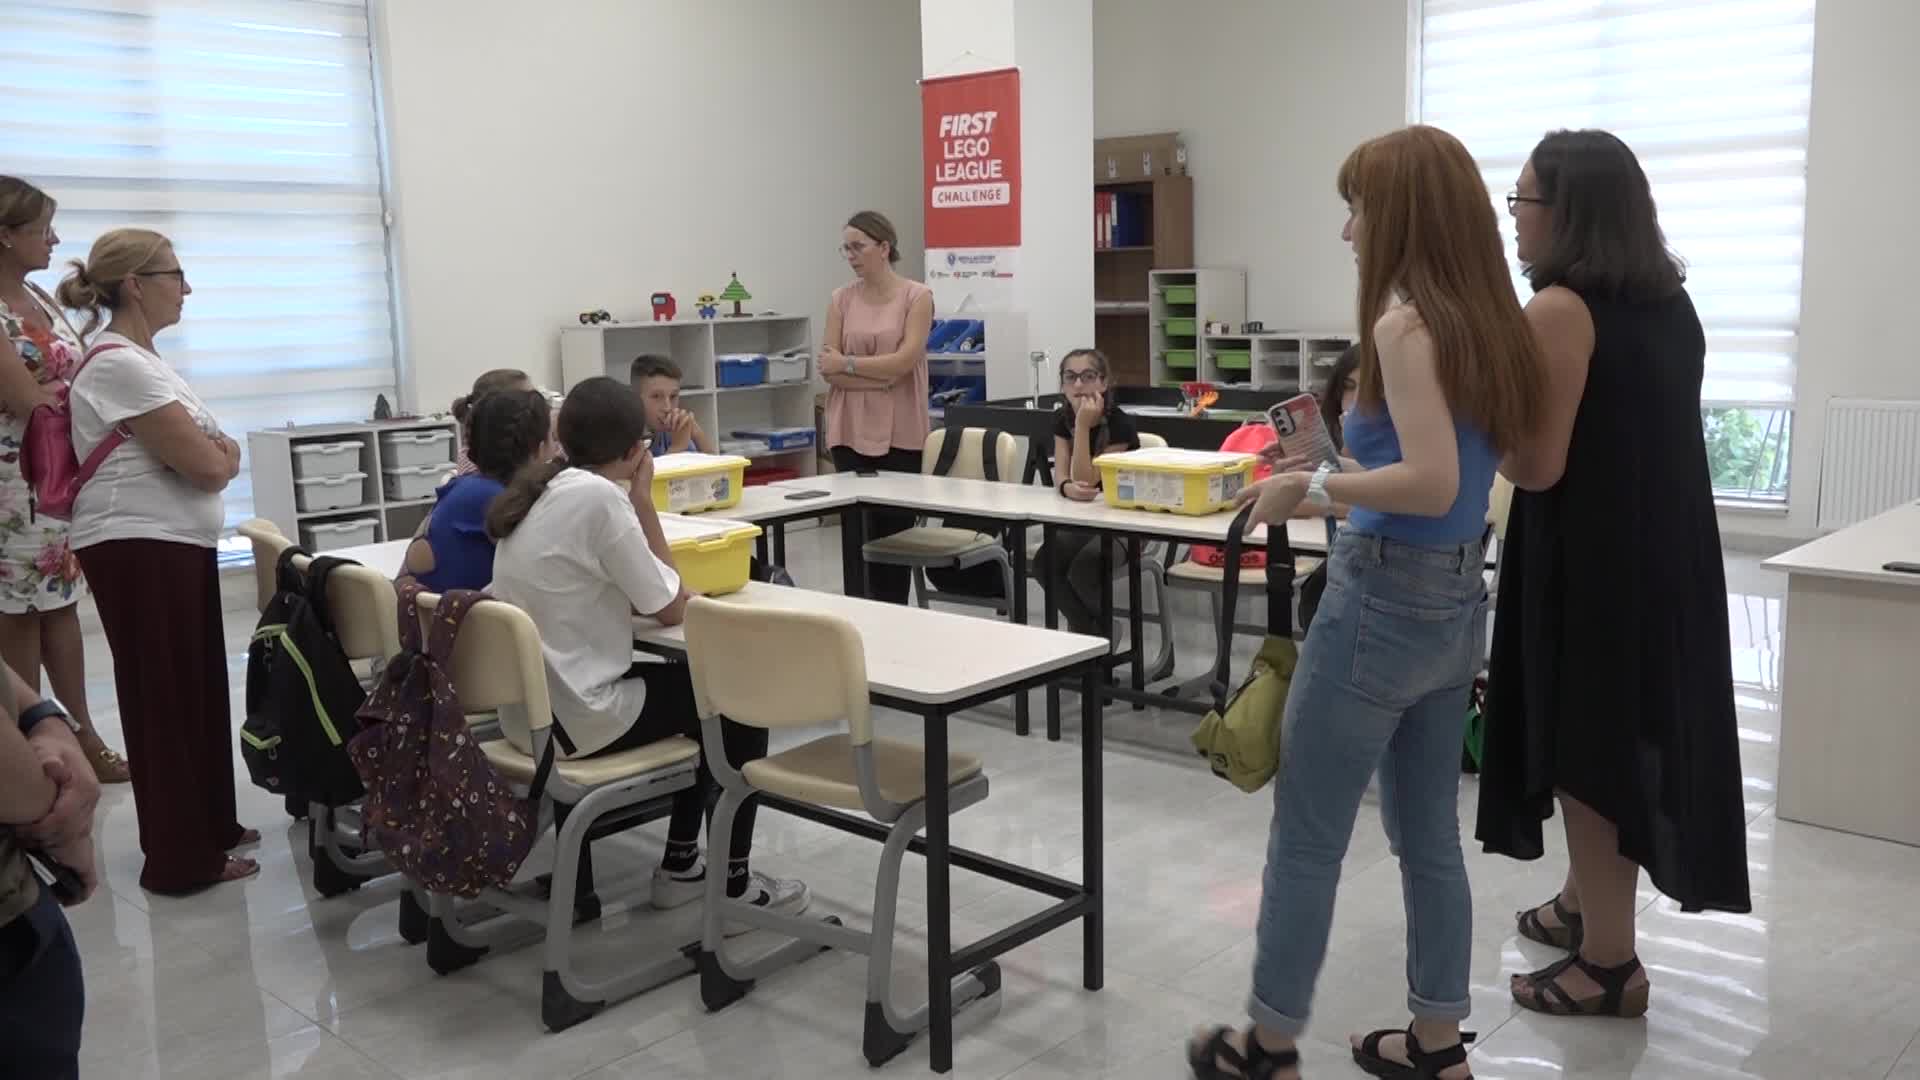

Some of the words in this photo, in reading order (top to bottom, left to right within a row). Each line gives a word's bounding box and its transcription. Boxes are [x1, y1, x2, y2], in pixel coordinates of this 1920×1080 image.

[939, 111, 998, 138] FIRST
[944, 137, 990, 160] LEGO
[936, 159, 1003, 182] LEAGUE
[937, 189, 1002, 203] CHALLENGE
